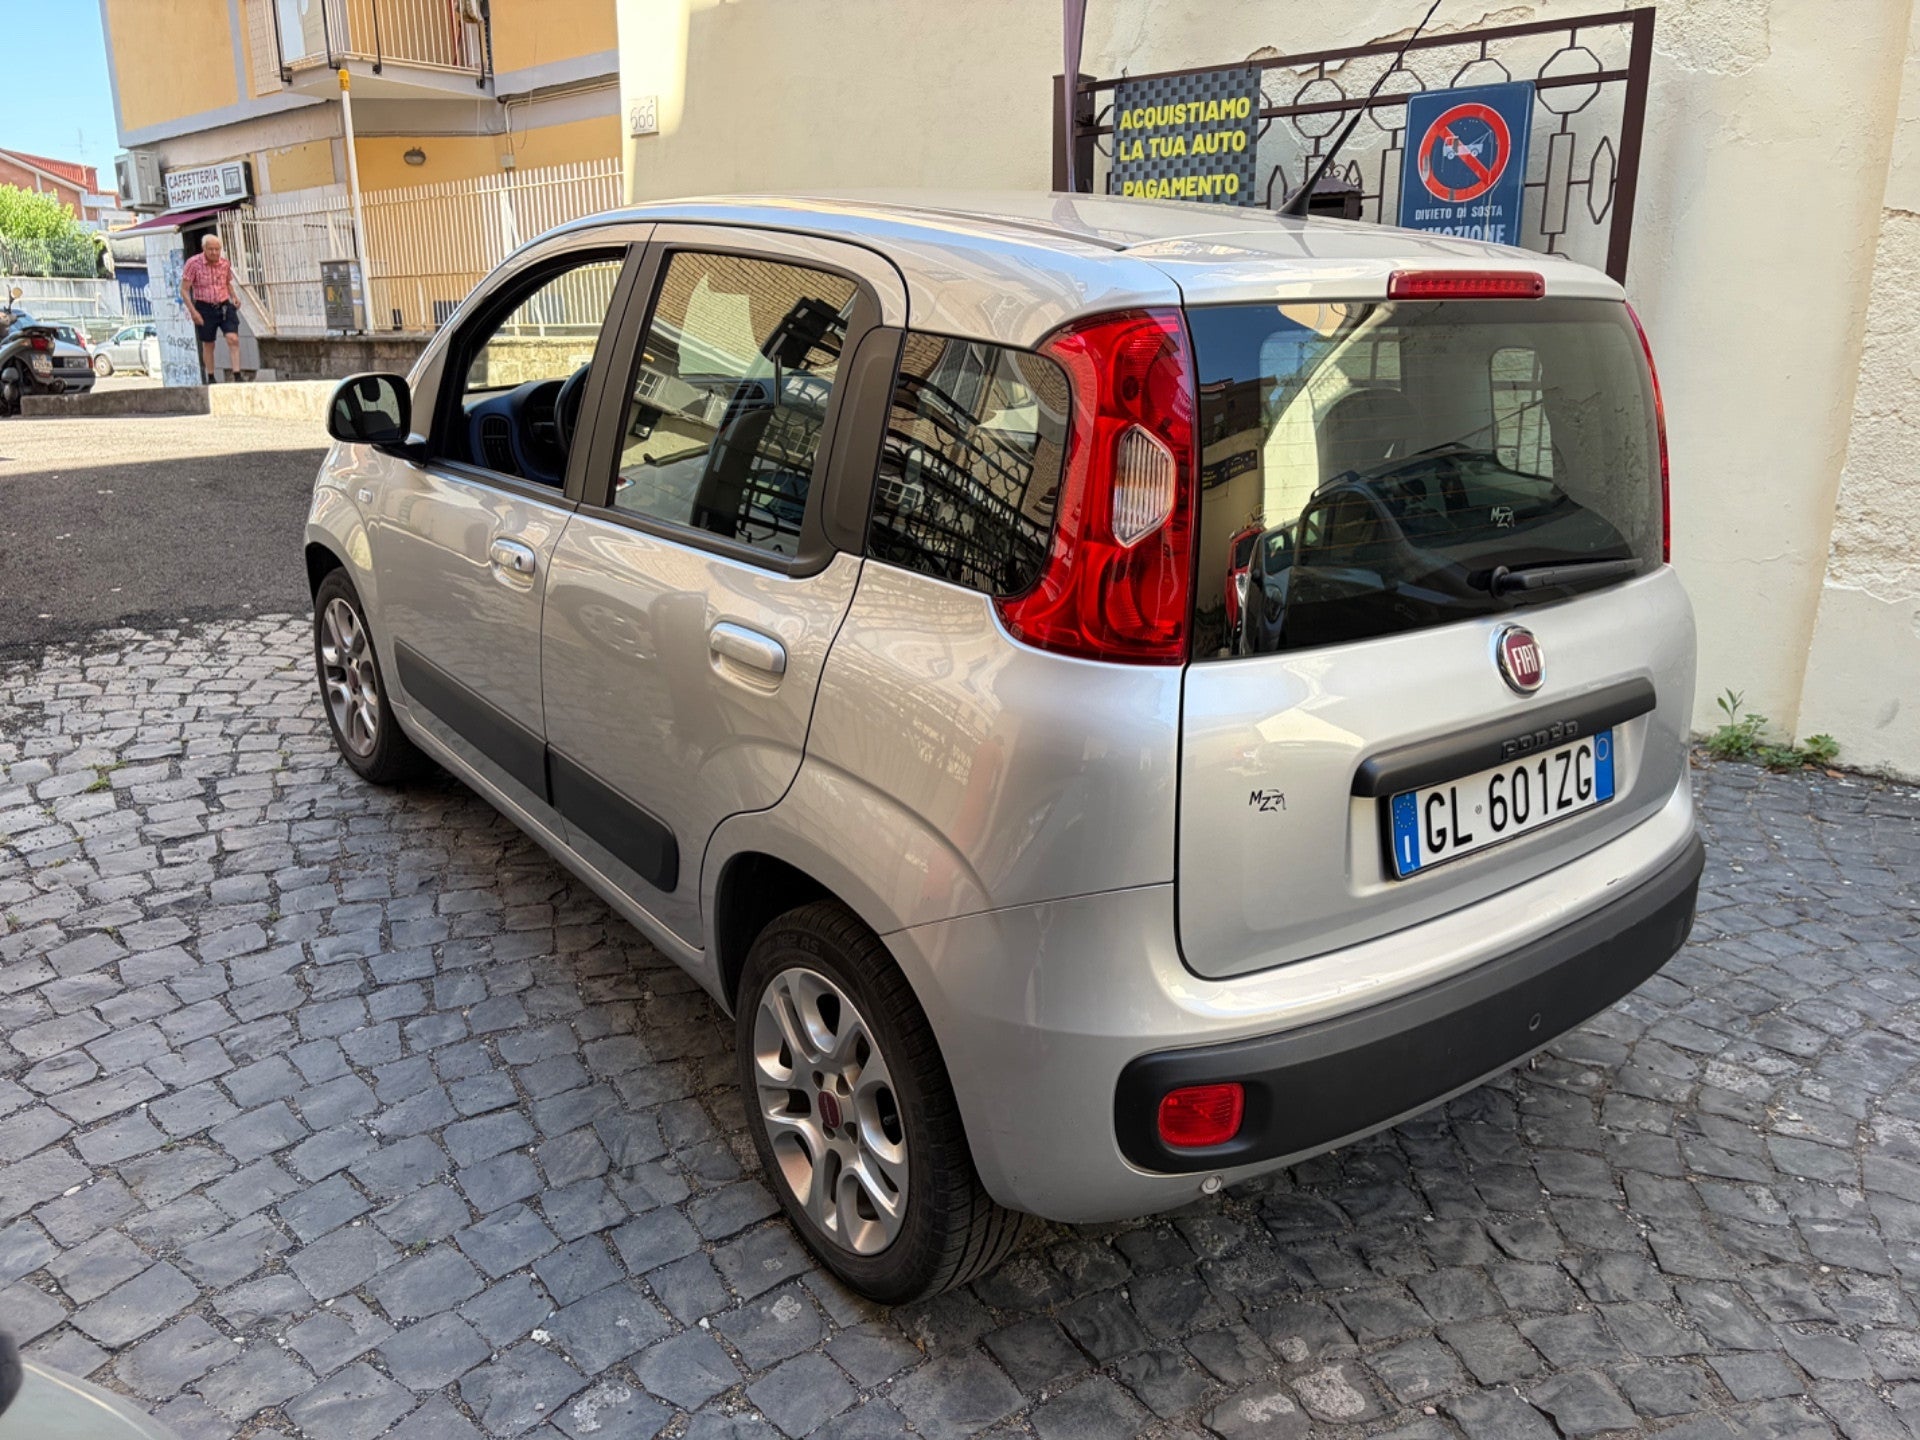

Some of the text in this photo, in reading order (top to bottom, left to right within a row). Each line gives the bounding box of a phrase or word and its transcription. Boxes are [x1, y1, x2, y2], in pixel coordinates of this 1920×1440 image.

[1119, 97, 1250, 130] ACQUISTIAMO
[1120, 130, 1246, 161] LA TUA AUTO
[168, 168, 219, 189] CAFFETTERIA
[1123, 173, 1239, 198] PAGAMENTO
[170, 184, 221, 205] HAPPY HOUR
[1415, 205, 1503, 220] DIVIETO DI SOSTA
[1421, 224, 1506, 244] ZIONE
[1511, 644, 1538, 676] FIAT
[1425, 744, 1592, 854] GL 601ZG
